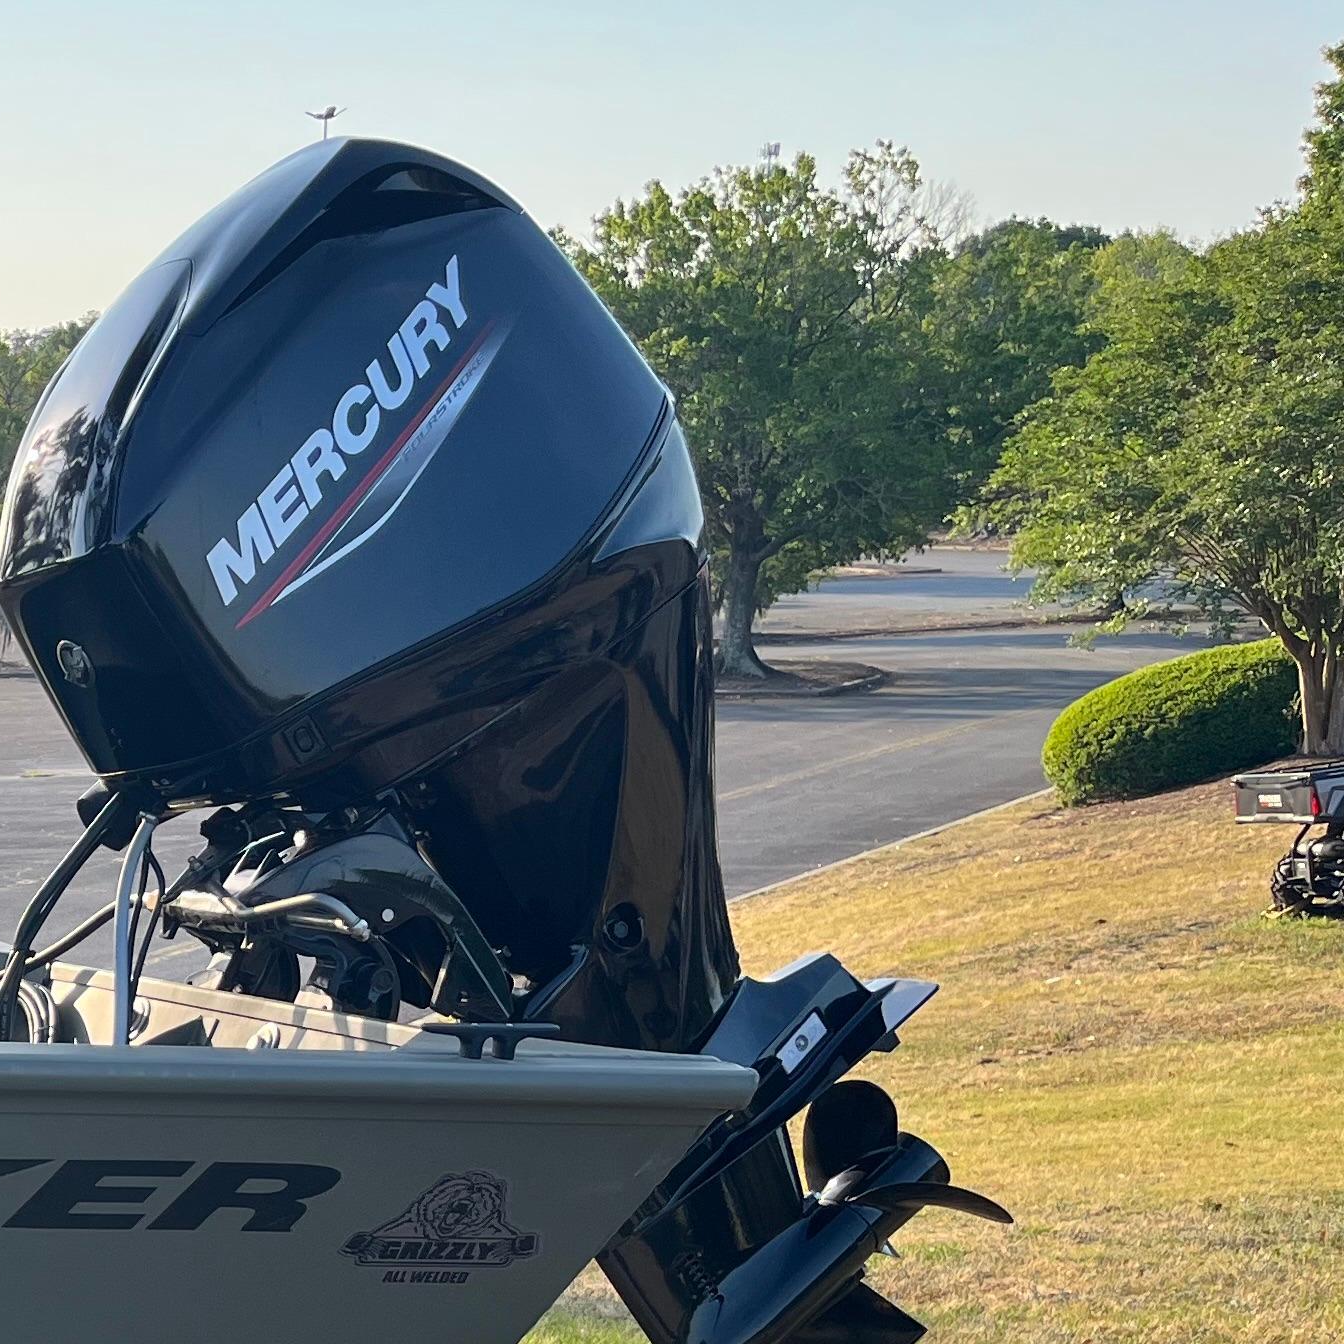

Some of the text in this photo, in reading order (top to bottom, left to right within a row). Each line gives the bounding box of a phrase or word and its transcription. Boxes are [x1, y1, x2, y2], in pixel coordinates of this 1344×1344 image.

[205, 253, 469, 607] MERCURY
[402, 351, 490, 462] FOURSTROKE
[378, 1241, 498, 1260] GRIZZLY
[382, 1270, 470, 1284] ALL WELDED
